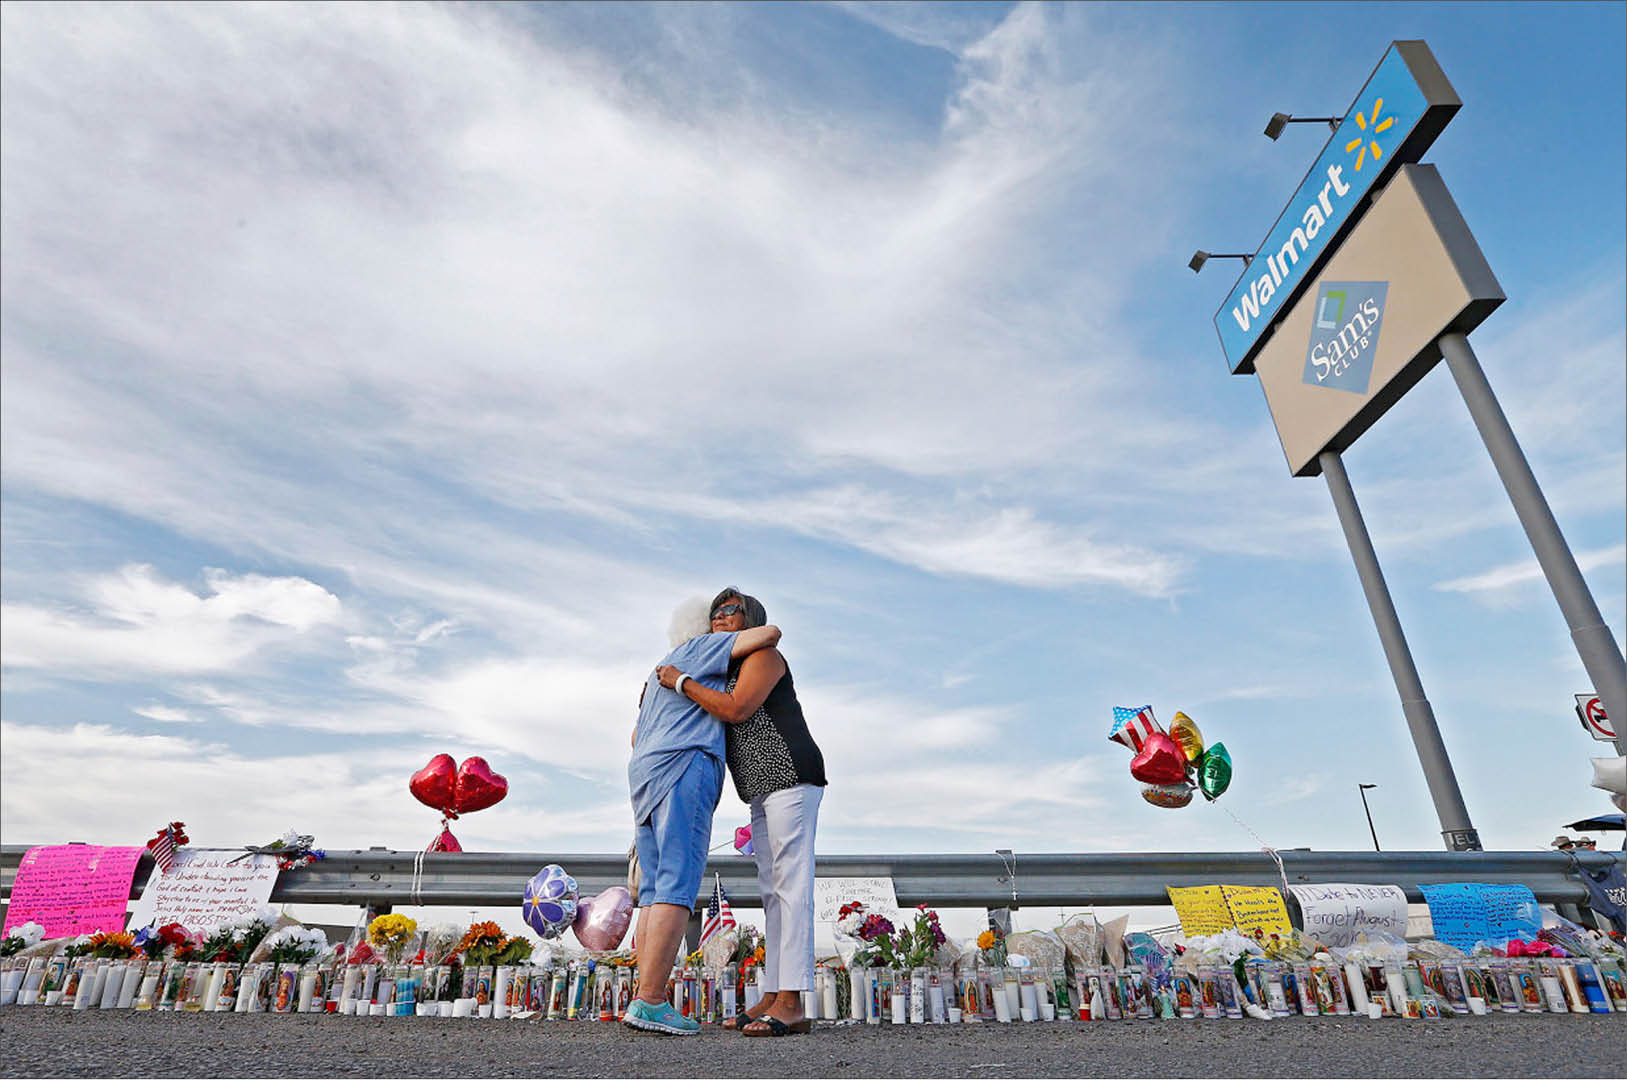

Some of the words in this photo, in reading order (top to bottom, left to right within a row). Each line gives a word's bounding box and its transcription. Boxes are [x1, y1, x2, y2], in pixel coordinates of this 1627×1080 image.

[1232, 164, 1350, 332] Walmart
[1311, 298, 1379, 382] Sam's
[1303, 905, 1352, 935] Forget
[1352, 905, 1396, 930] August
